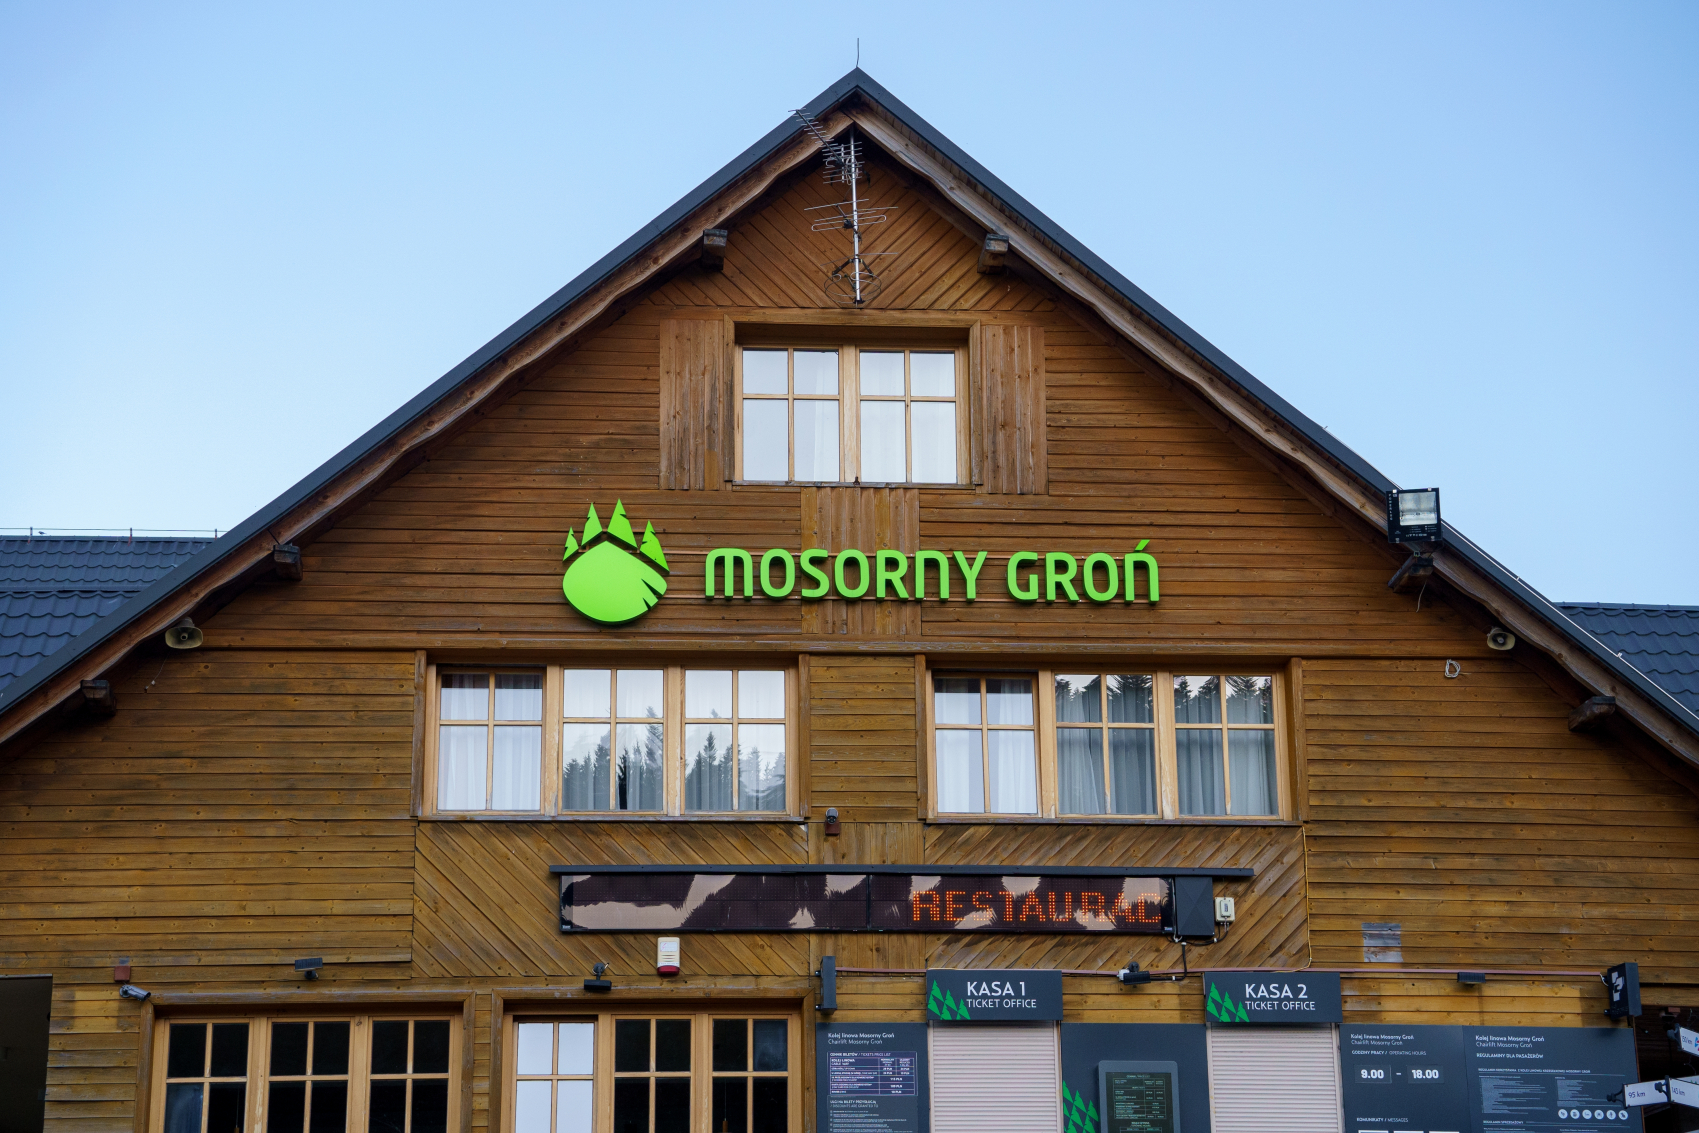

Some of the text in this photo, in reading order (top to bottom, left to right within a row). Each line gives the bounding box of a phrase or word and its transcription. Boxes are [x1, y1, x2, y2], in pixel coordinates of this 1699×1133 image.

[705, 539, 1160, 604] MOSORNY GROŃ
[966, 981, 1026, 996] KASA 1
[1245, 984, 1308, 999] KASA 2
[966, 998, 1036, 1008] TICKET OFFICE
[1245, 1001, 1316, 1011] TICKET OFFICE
[1360, 1069, 1384, 1079] 9.00
[1412, 1069, 1439, 1079] 18.00
